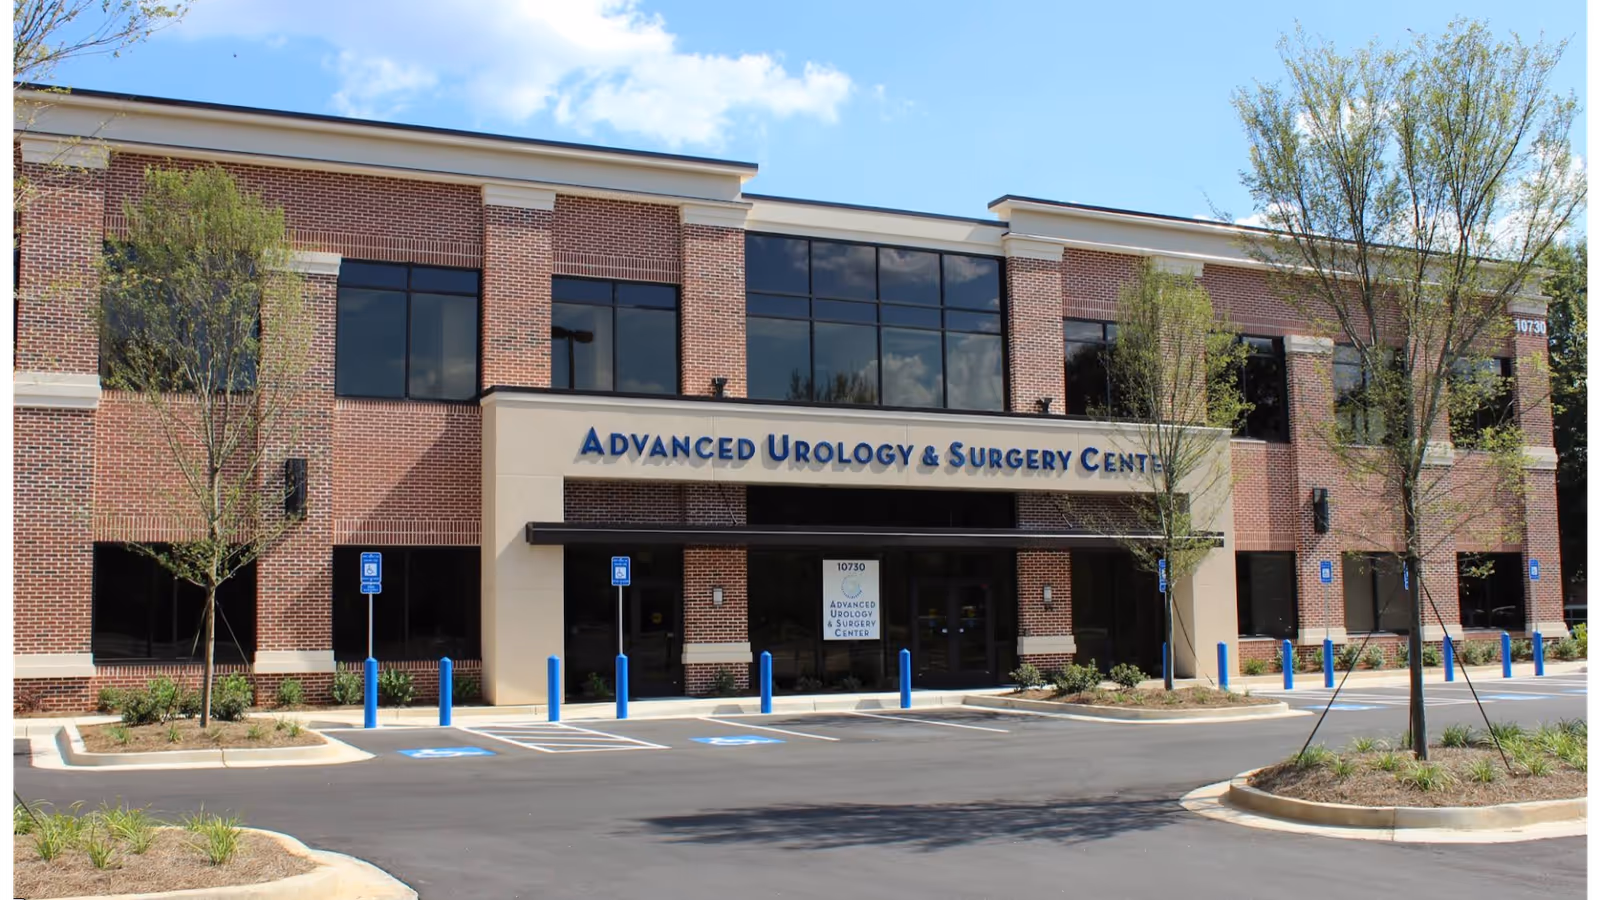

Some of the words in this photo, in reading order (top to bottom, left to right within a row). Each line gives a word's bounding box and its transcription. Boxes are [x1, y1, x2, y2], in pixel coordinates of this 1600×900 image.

[1514, 319, 1547, 334] 10730
[580, 426, 756, 461] ADVANCED
[768, 433, 915, 466] UROLOGY
[922, 445, 940, 467] &
[949, 441, 1073, 472] SURGERY
[1080, 446, 1179, 474] CENTE
[837, 562, 866, 572] 10730
[830, 600, 876, 609] ADVANCED
[830, 609, 873, 618] UROLOGY
[827, 620, 833, 628] &
[836, 618, 877, 628] SURGERY
[834, 628, 870, 637] CENTER
